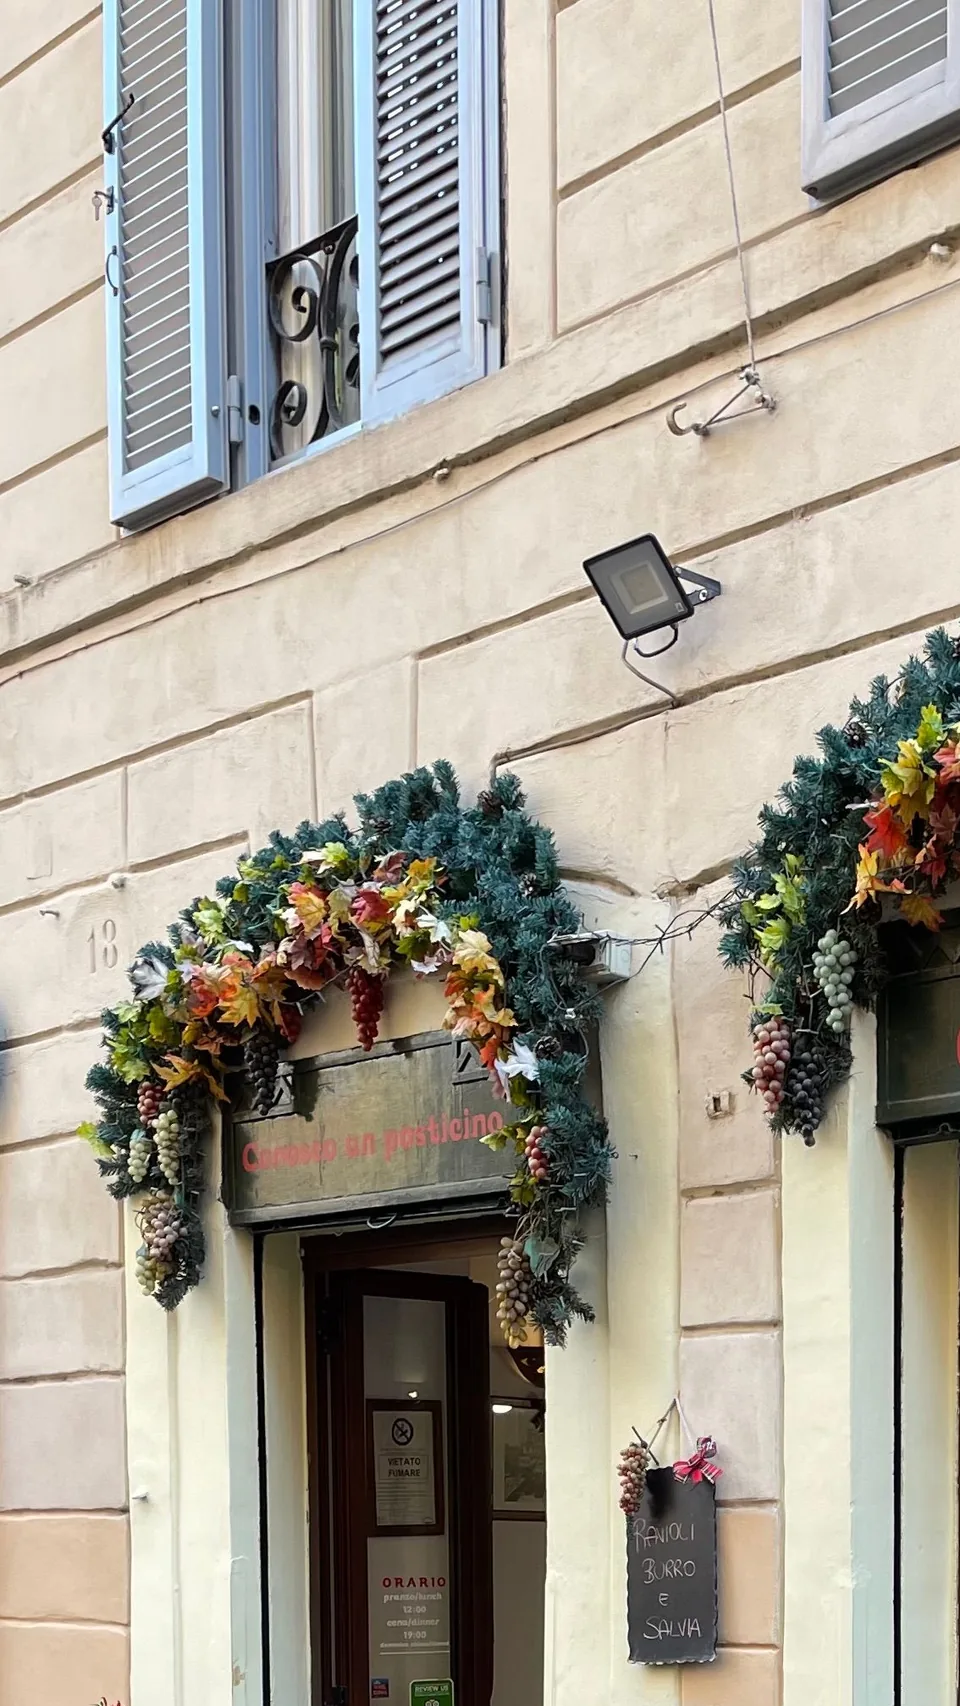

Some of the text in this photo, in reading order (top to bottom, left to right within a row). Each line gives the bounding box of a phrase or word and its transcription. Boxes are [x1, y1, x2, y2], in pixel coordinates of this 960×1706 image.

[85, 919, 118, 973] 18
[345, 1132, 376, 1159] un
[388, 1457, 421, 1466] VIETATO
[388, 1469, 421, 1477] FUMARE
[633, 1518, 695, 1553] RAVIOLI
[642, 1558, 696, 1584] BURRO
[382, 1577, 446, 1588] ORARIO
[403, 1605, 427, 1614] 12:00
[403, 1631, 427, 1640] 19:00
[642, 1616, 702, 1641] SALVIA
